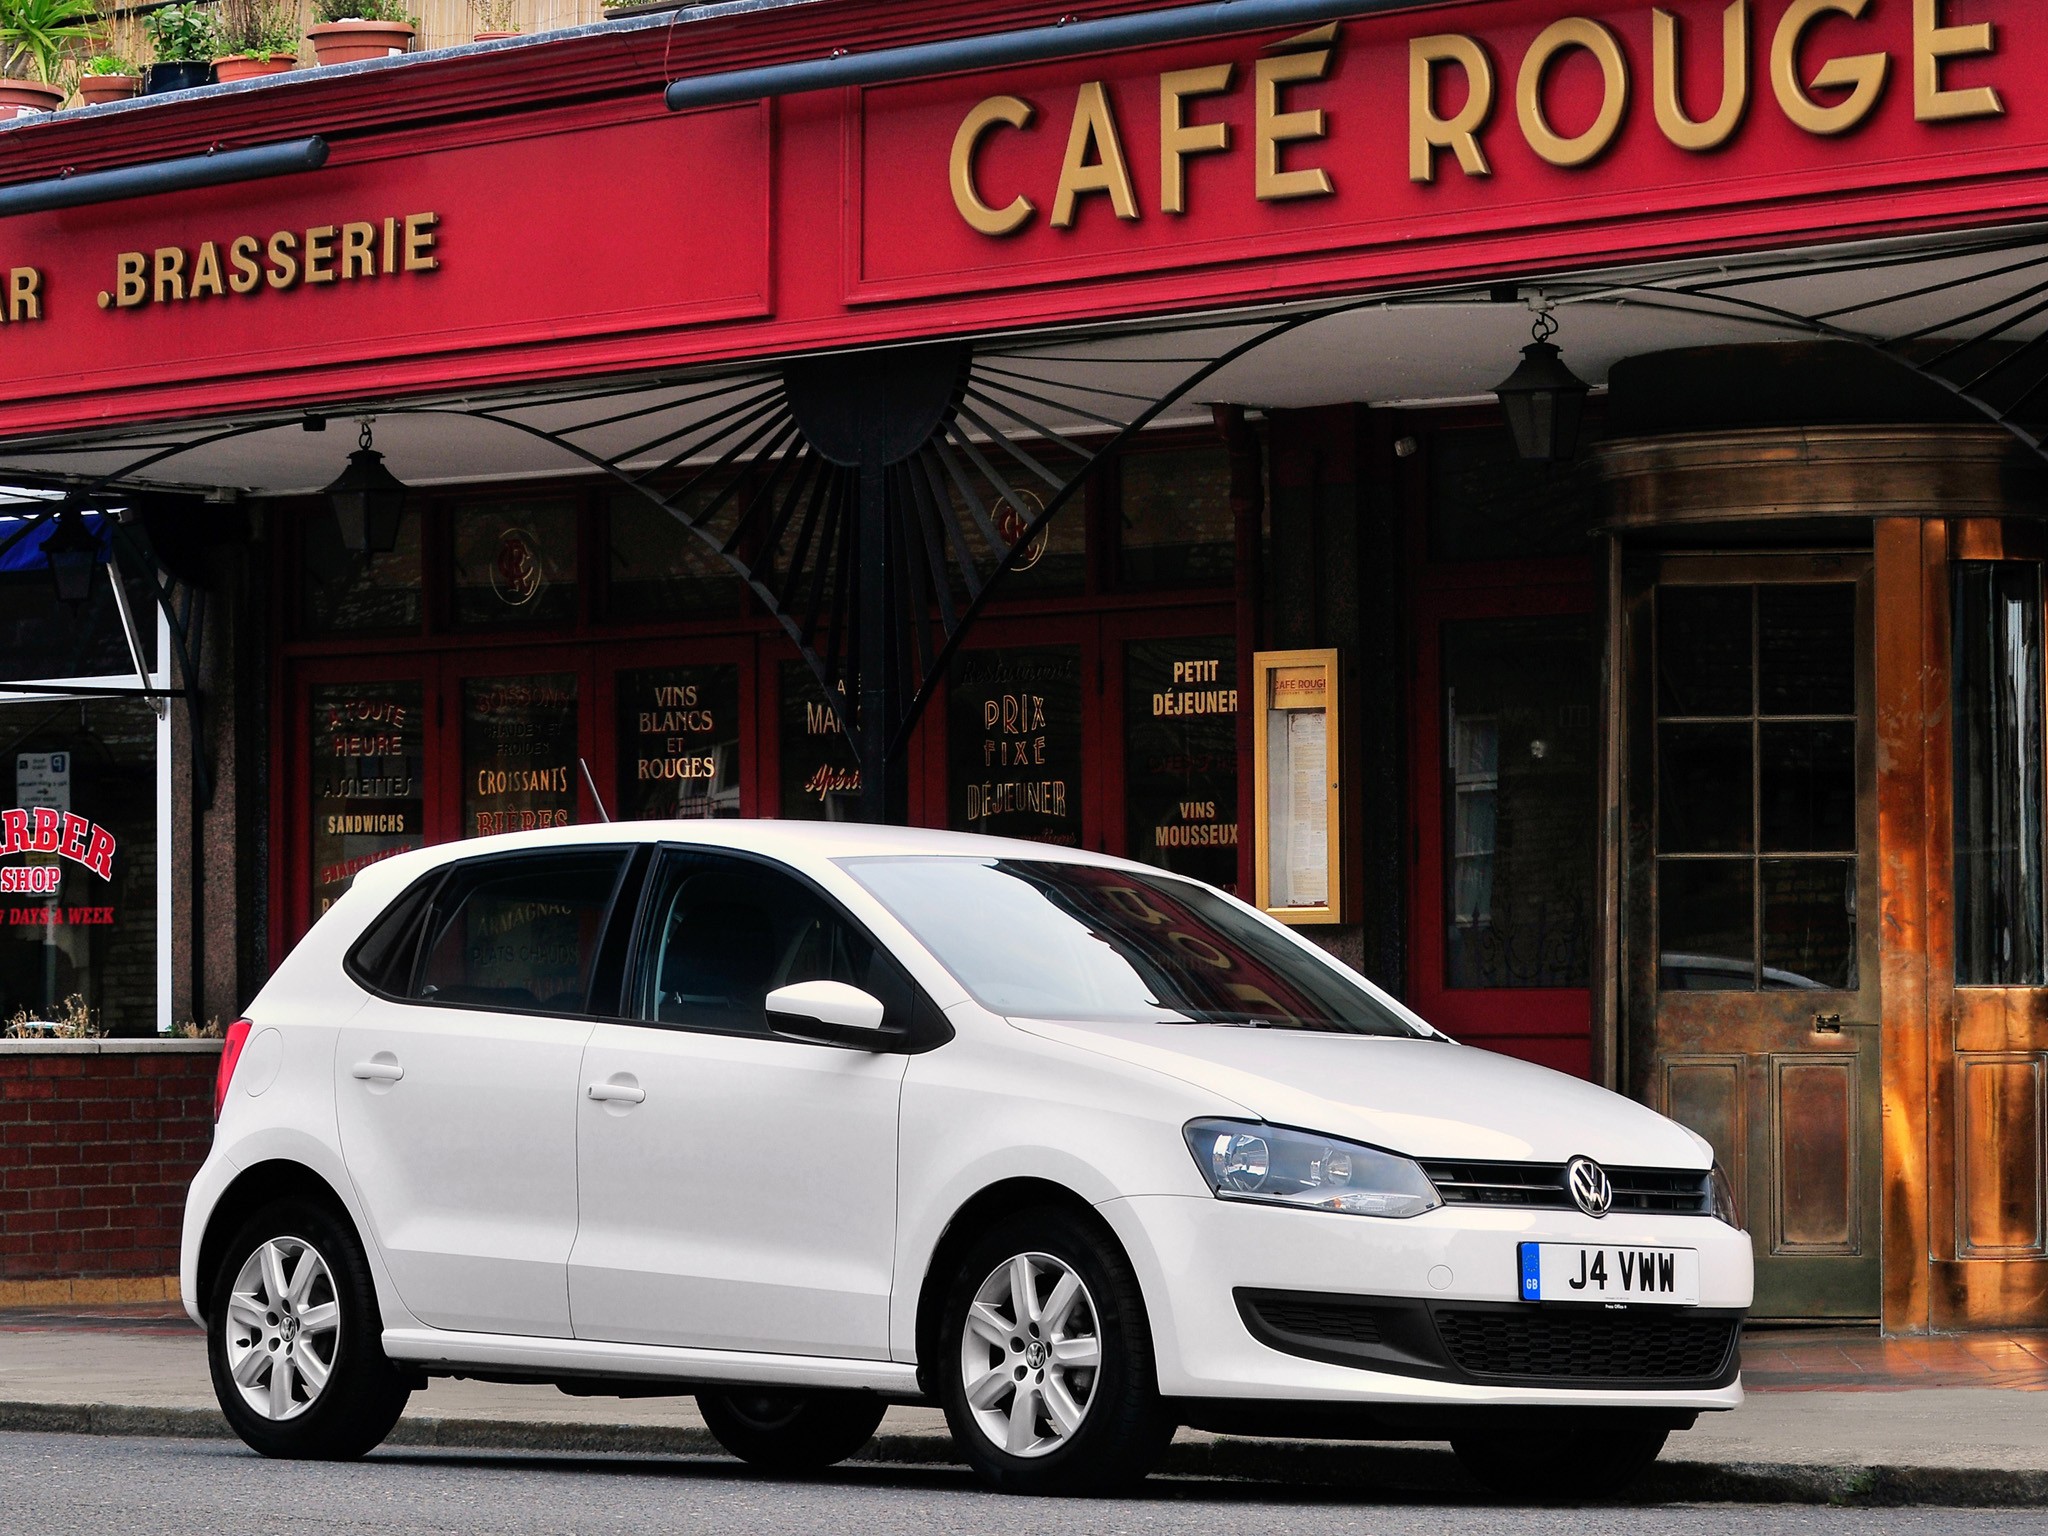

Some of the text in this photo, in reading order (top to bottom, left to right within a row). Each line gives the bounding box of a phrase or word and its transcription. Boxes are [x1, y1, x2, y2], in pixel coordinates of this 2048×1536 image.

[949, 0, 2005, 237] CAFÉ ROUGE
[1172, 659, 1219, 684] PETIT
[654, 685, 699, 707] VINS
[1152, 687, 1238, 716] DÉJEUNER
[344, 699, 407, 728] TOUTE
[639, 710, 714, 733] BLANCS
[984, 693, 1046, 735] PRIX
[335, 733, 402, 758] HEURE
[666, 737, 685, 753] ET
[983, 736, 1046, 767] FIXE
[477, 766, 568, 796] CROISSANTS
[637, 756, 716, 781] ROUGES
[323, 776, 412, 799] ASSIETTES
[967, 780, 1067, 822] DÉJEUNER
[1179, 801, 1216, 820] VINS
[327, 813, 405, 835] SANDWICHS
[1155, 823, 1238, 847] MOUSSEUX
[0, 806, 117, 882] RBER
[1, 866, 62, 893] SHOP
[9, 907, 50, 926] DAYS
[52, 906, 65, 926] A
[67, 905, 117, 925] WEEK
[477, 903, 573, 936] ARMAGNAC
[1568, 1250, 1675, 1293] J4 VWW
[1526, 1279, 1538, 1291] GB
